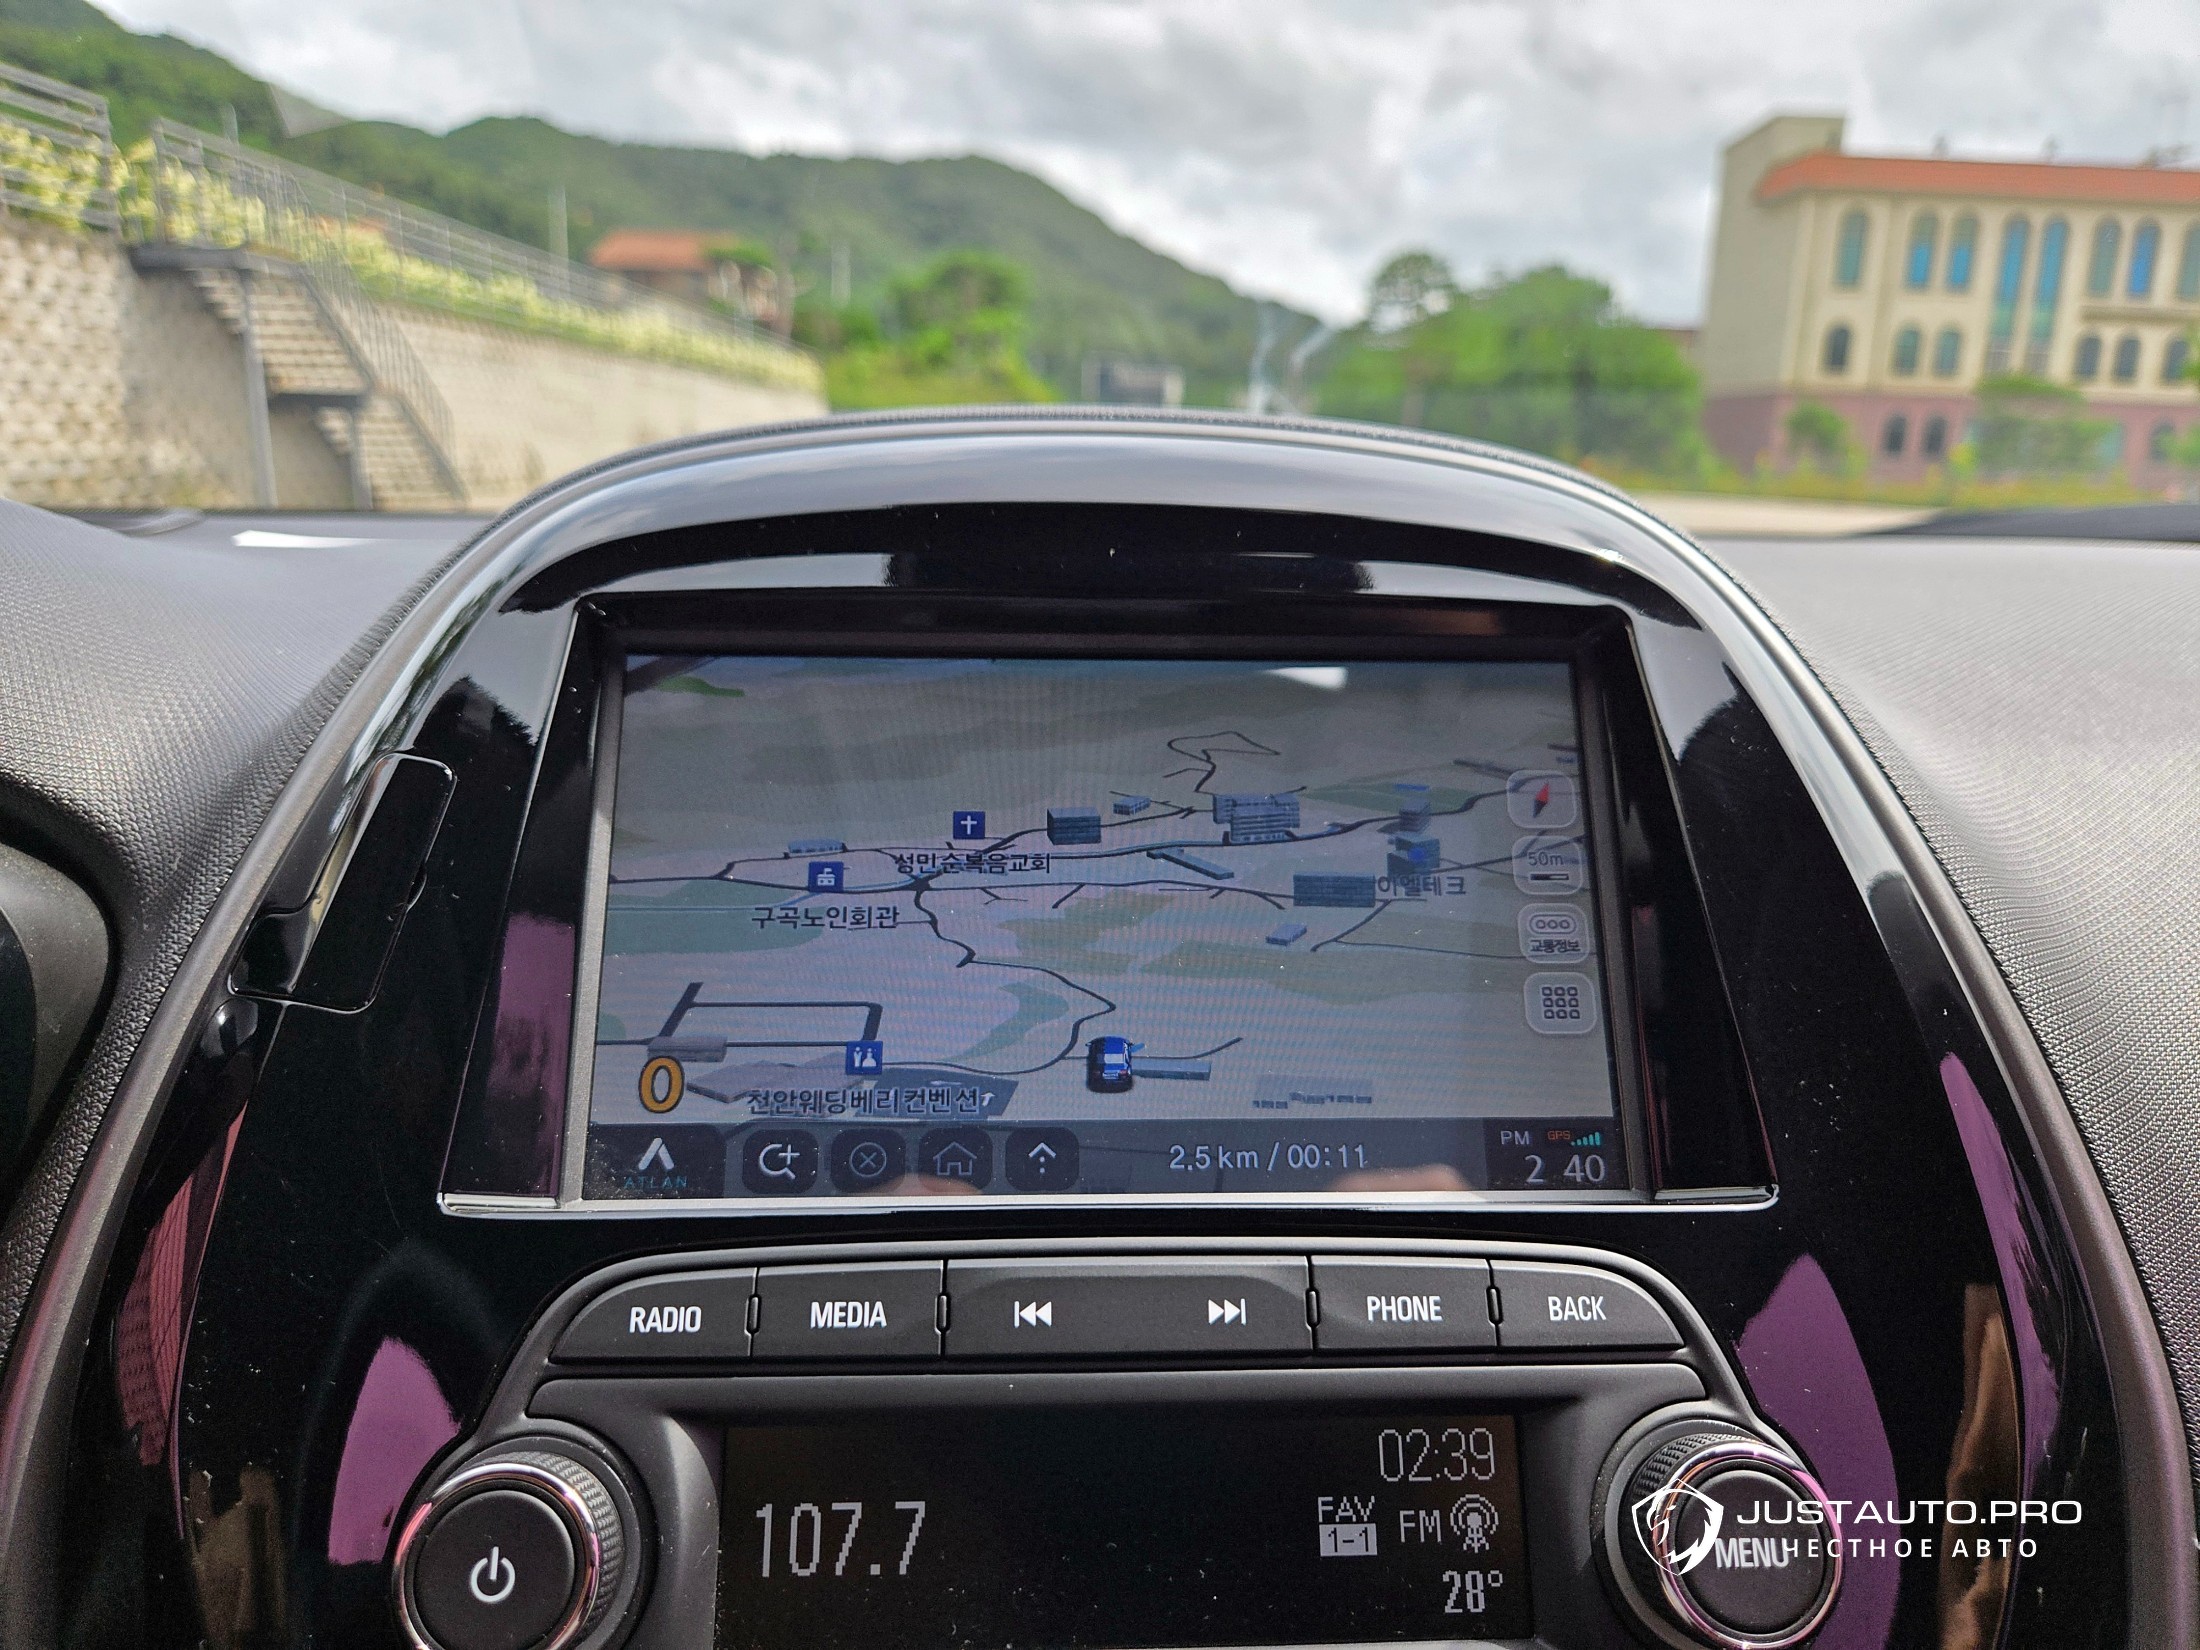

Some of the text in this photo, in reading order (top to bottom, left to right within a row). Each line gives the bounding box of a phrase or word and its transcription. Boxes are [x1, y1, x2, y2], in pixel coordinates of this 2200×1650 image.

[894, 851, 1051, 874] 성민순복음교회
[1528, 851, 1565, 867] 50m
[751, 905, 900, 930] 구곡노인회관
[1530, 939, 1581, 954] 교통정보
[1501, 1130, 1530, 1146] PM
[1547, 1130, 1570, 1140] GPS
[1287, 1144, 1367, 1169] 00:11
[624, 1175, 687, 1189] ATLAN
[629, 1306, 702, 1333] RADIO
[810, 1301, 887, 1328] MEDIA
[1367, 1296, 1442, 1321] PHONE
[1548, 1296, 1607, 1321] BACK
[1378, 1428, 1495, 1482] 02:39
[1318, 1496, 1375, 1523] FAV
[1400, 1510, 1441, 1542] FM
[755, 1501, 926, 1578] 107.7
[1328, 1527, 1369, 1553] 1-1
[1715, 1538, 1789, 1569] MENU
